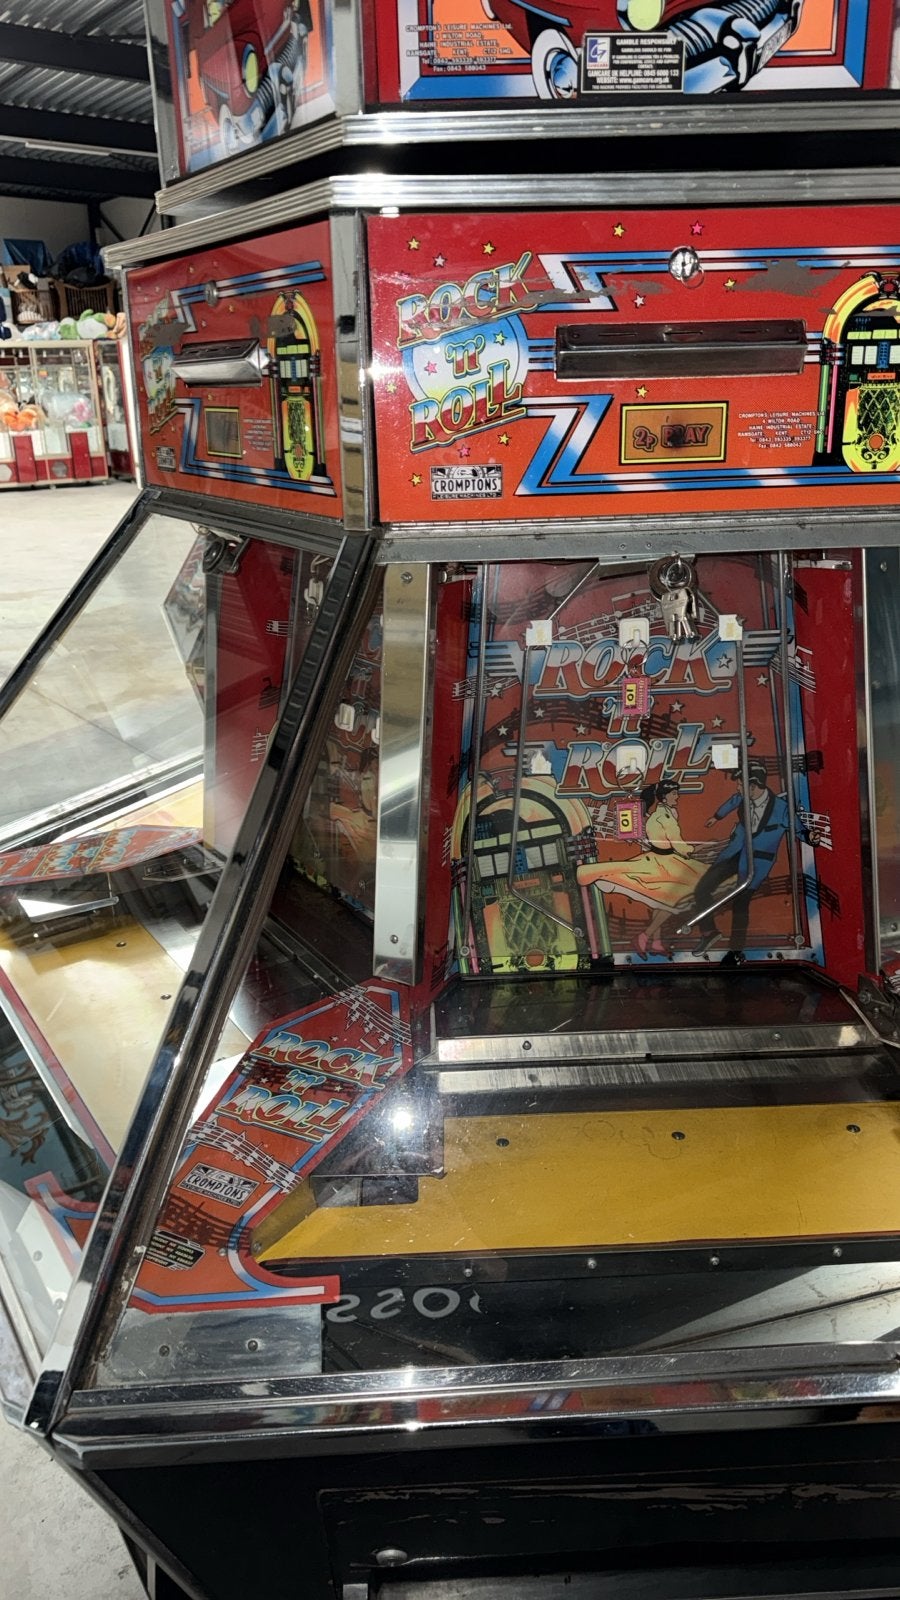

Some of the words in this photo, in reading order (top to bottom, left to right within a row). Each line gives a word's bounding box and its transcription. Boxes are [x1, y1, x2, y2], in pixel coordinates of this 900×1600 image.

[397, 252, 538, 348] ROCK
[409, 360, 528, 454] ROLL
[634, 427, 656, 450] 2p
[662, 424, 711, 446] PAY
[434, 479, 497, 492] CROMPTONS
[534, 629, 731, 698] ROCK
[555, 724, 712, 798] ROLL
[250, 1032, 400, 1089] ROCK
[215, 1085, 349, 1142] ROLL
[187, 1174, 246, 1200] CROMPTONS
